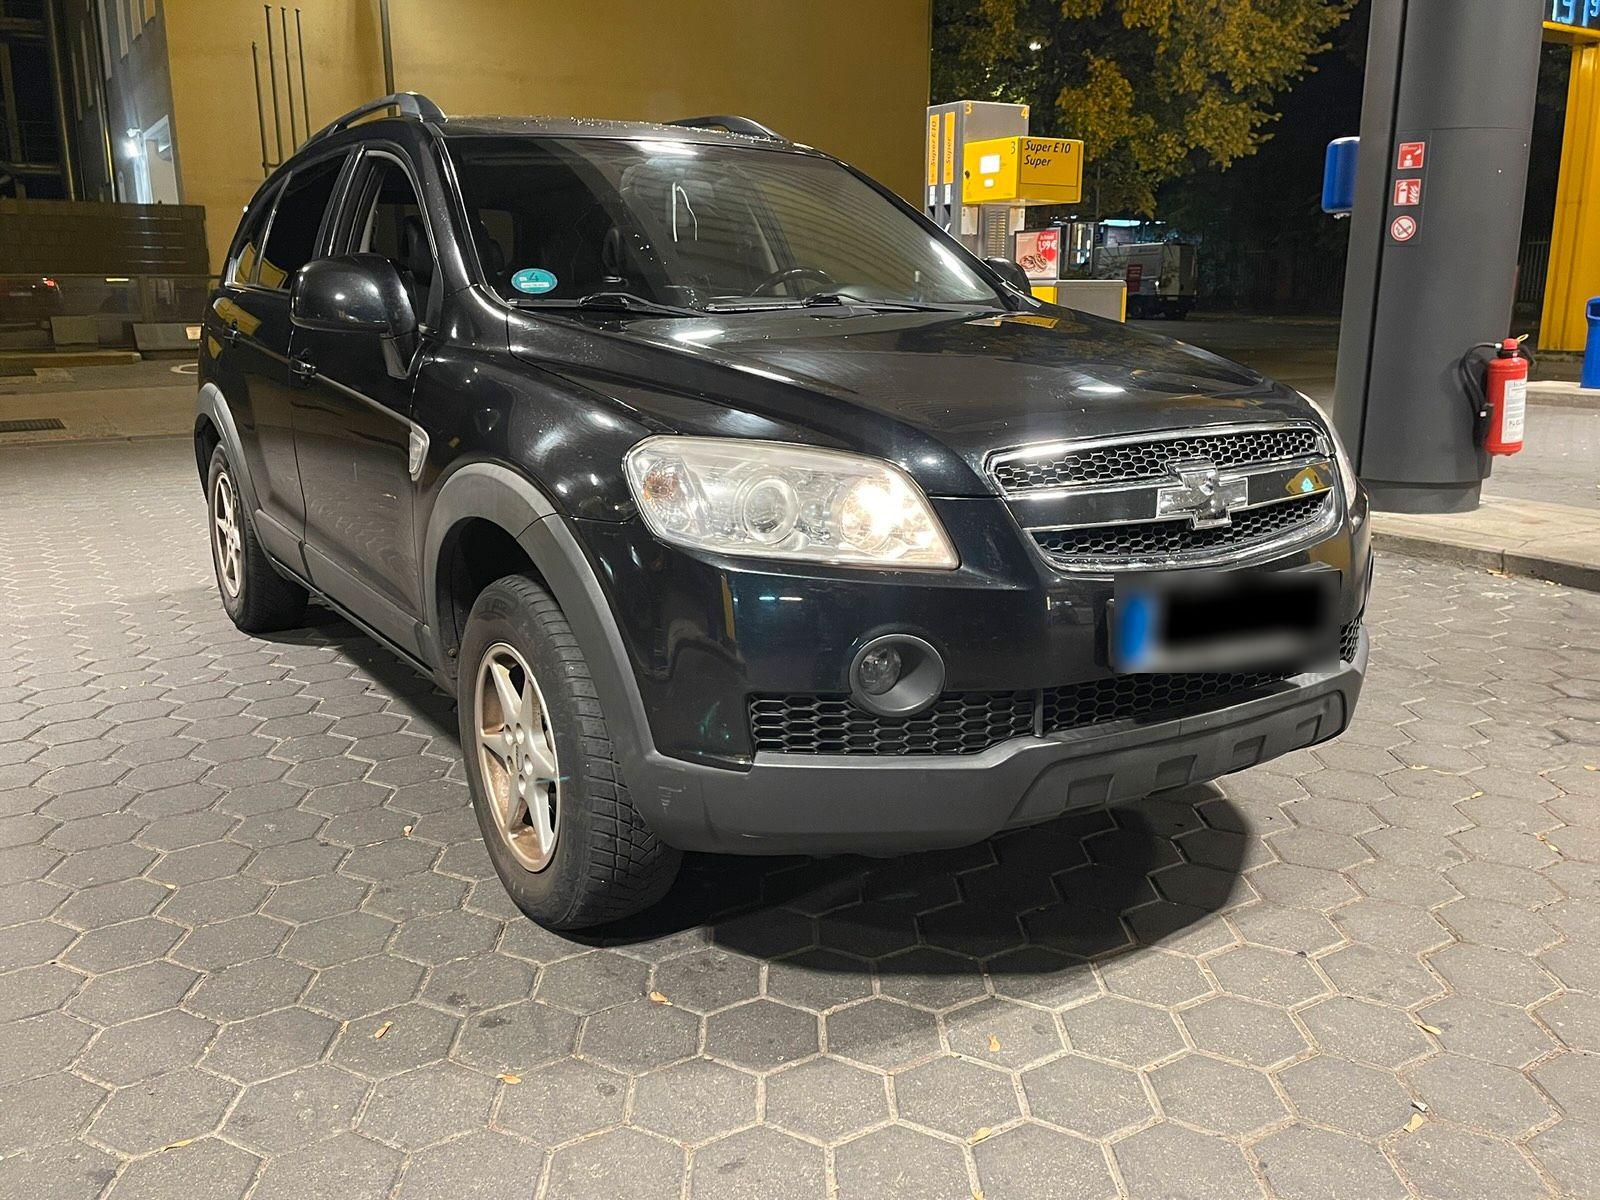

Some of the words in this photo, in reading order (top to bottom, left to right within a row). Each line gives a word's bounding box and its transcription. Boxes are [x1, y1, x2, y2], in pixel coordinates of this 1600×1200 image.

[964, 102, 973, 115] 3
[1020, 108, 1028, 120] 4
[1010, 141, 1016, 155] 3
[1024, 140, 1052, 155] Super
[1053, 142, 1071, 154] E10
[1024, 155, 1051, 168] Super
